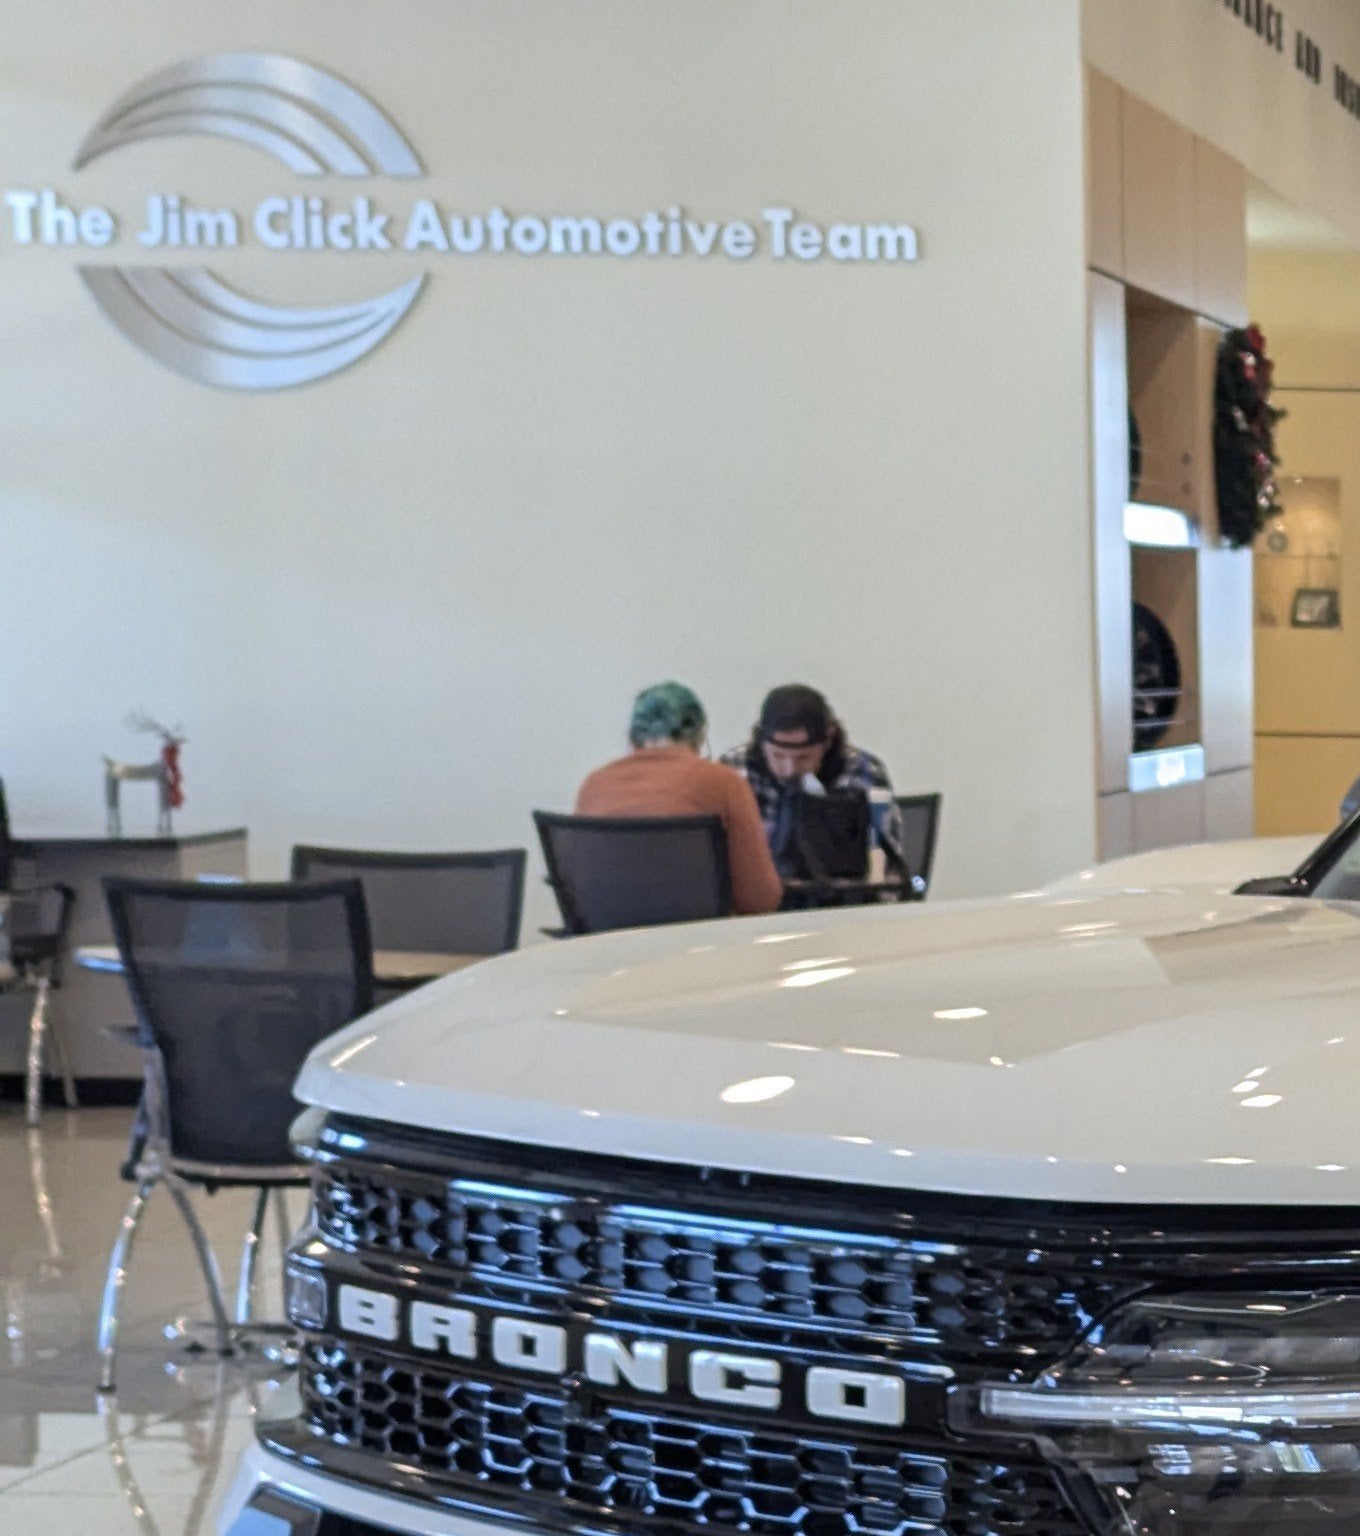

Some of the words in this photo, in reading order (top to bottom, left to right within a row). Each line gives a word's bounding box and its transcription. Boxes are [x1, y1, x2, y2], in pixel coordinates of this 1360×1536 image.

[7, 190, 114, 245] The
[137, 194, 239, 248] Jim
[254, 197, 392, 250] Click
[404, 200, 756, 257] Automotive
[763, 208, 919, 262] Team
[336, 1284, 907, 1428] BRONCO
